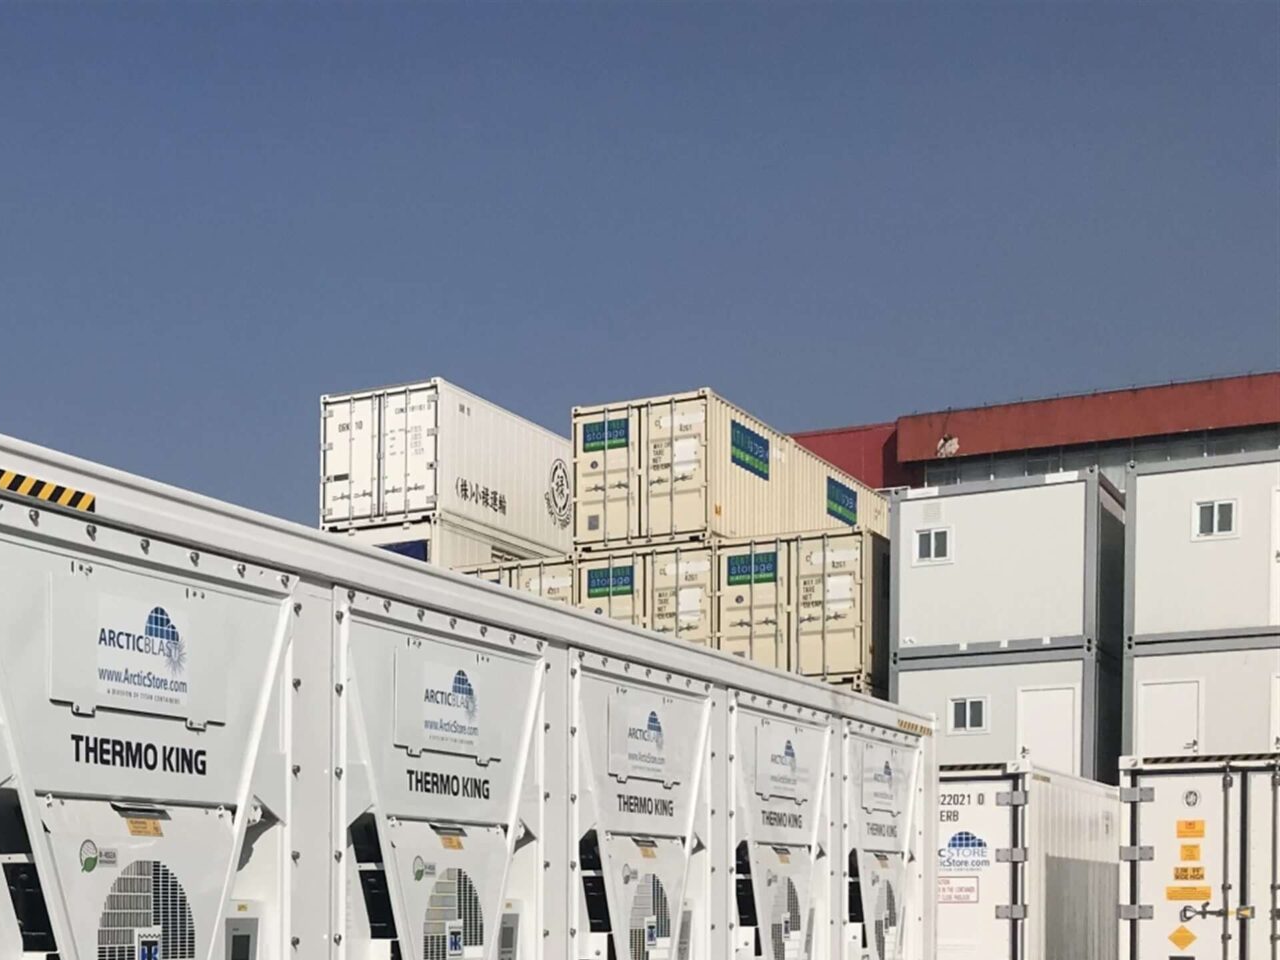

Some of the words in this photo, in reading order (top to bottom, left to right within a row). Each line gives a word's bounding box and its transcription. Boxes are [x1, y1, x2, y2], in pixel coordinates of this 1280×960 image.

[98, 667, 187, 693] www.ArcticStore.com
[71, 734, 158, 770] THERMO
[162, 746, 207, 775] KING
[407, 769, 459, 797] THERMO
[462, 776, 490, 800] KING
[617, 794, 653, 815] THERMO
[654, 798, 674, 817] KING
[940, 794, 971, 806] 22021
[761, 810, 787, 828] THERMO
[940, 810, 959, 822] ERB
[937, 848, 988, 858] CSTORE
[940, 858, 990, 868] icStore.com
